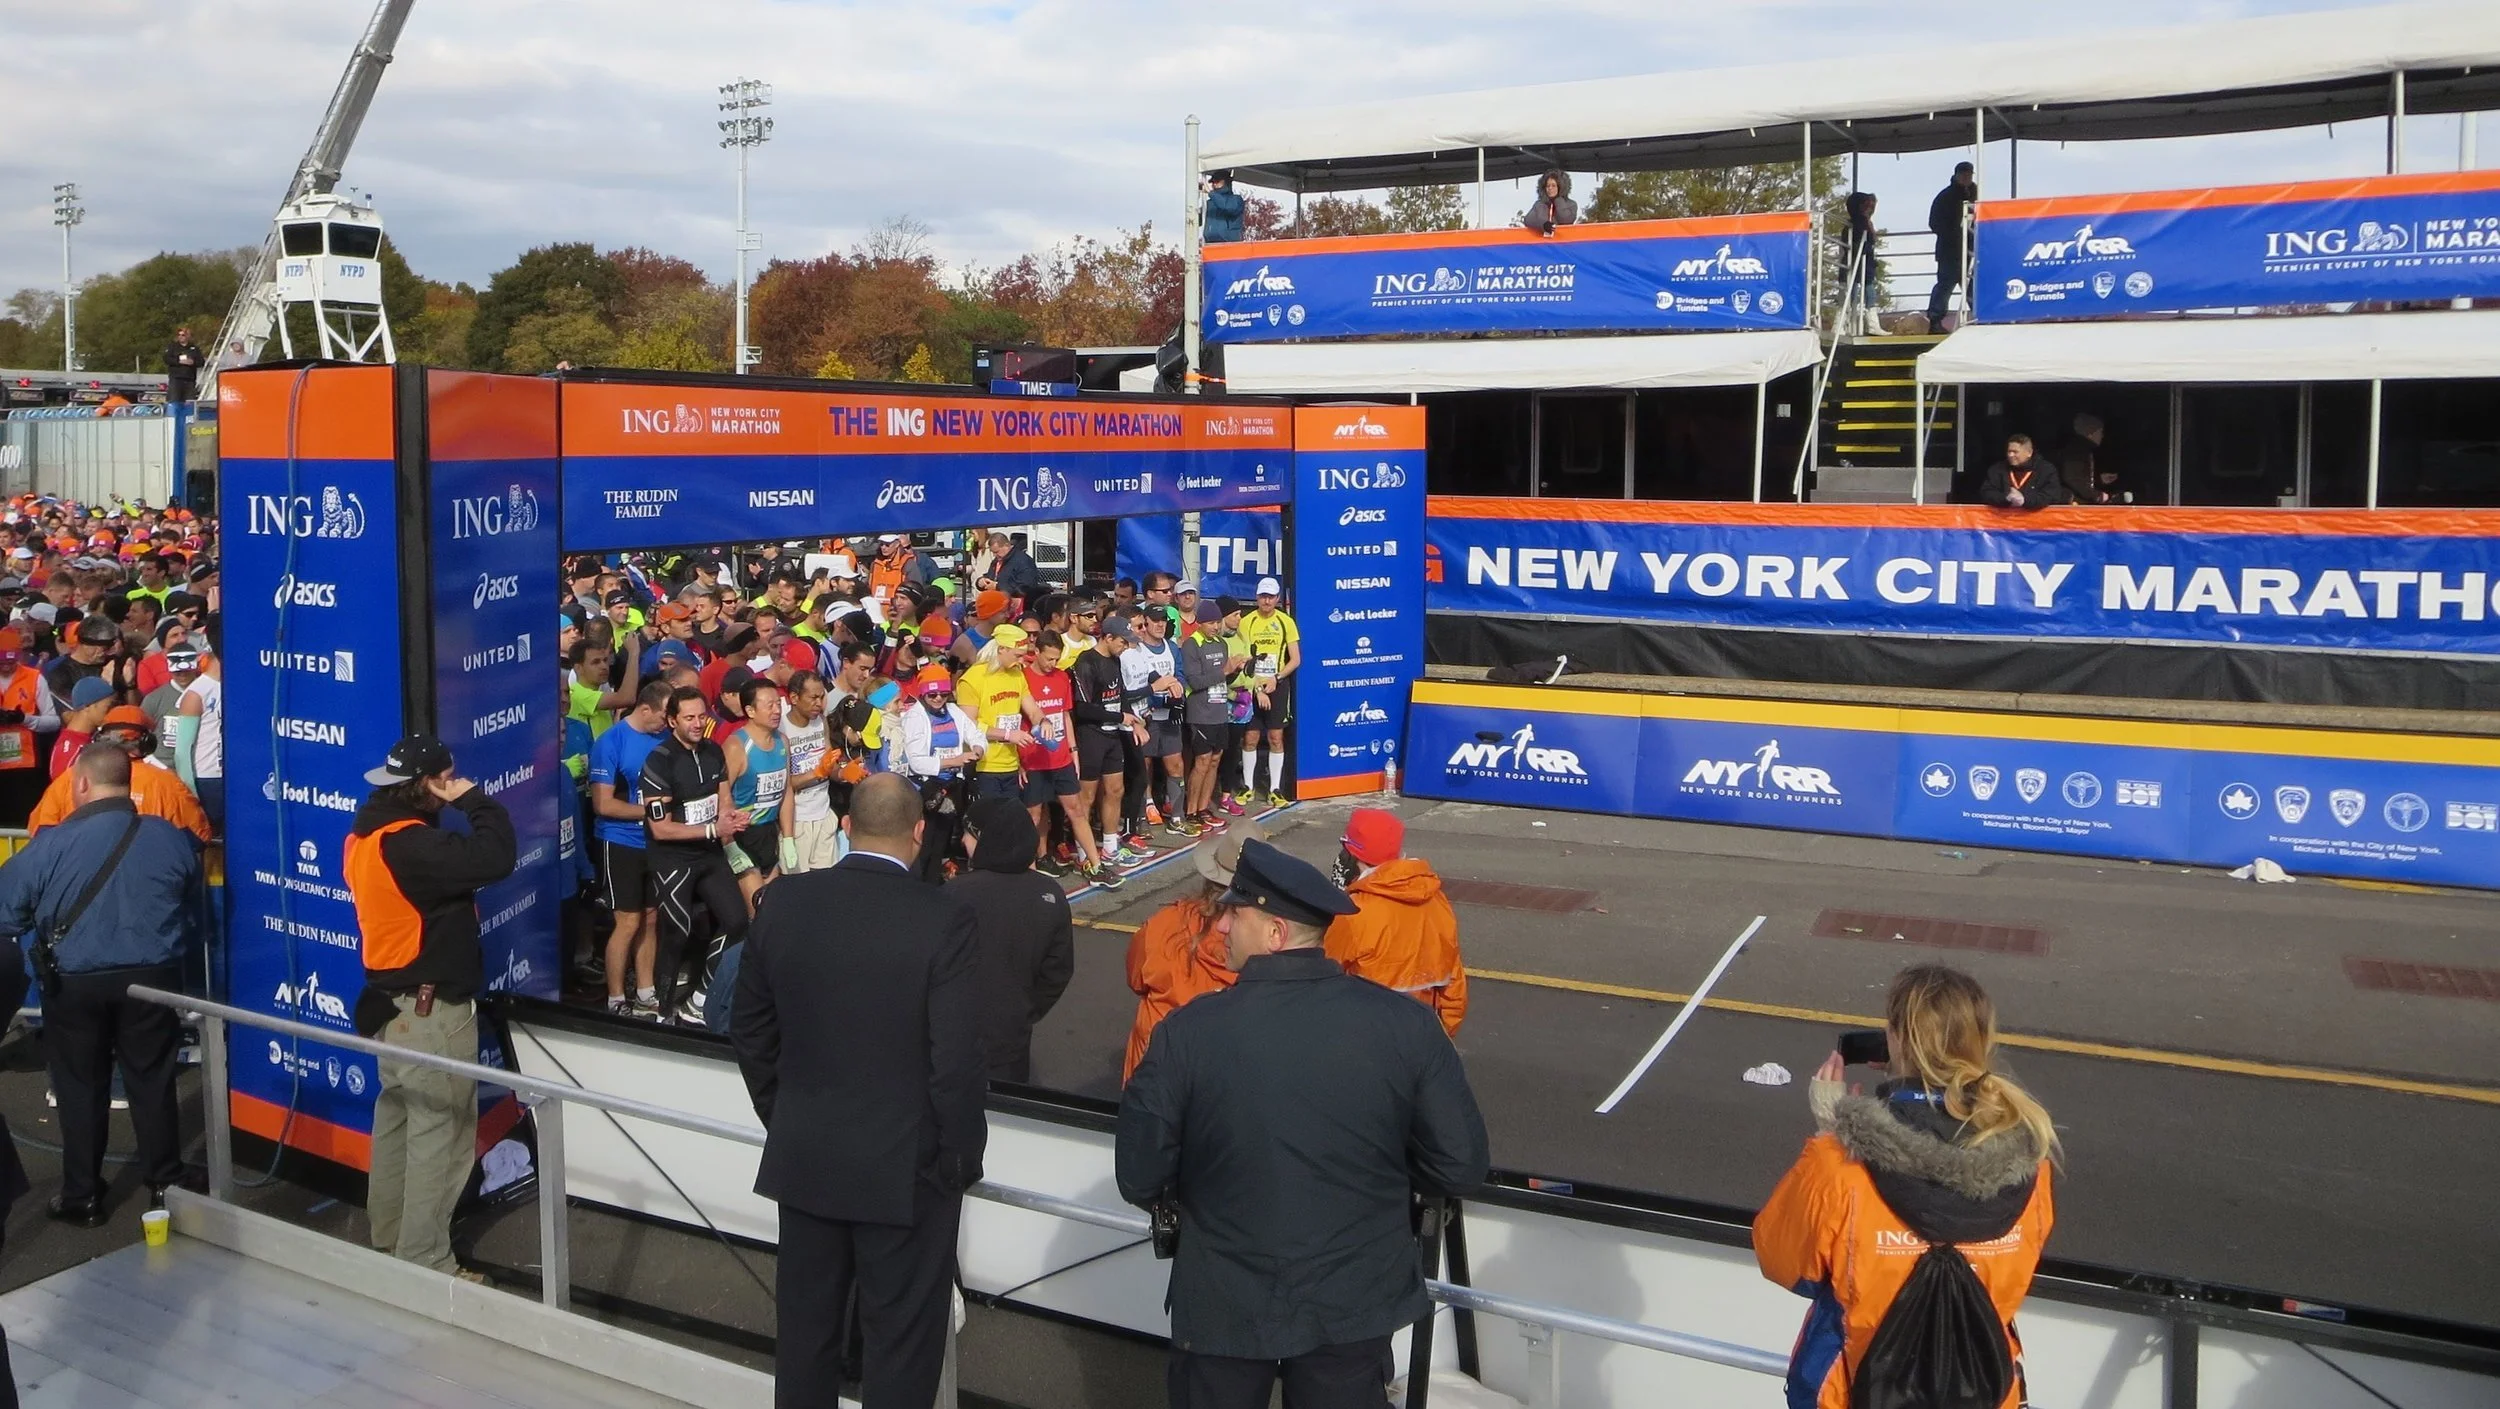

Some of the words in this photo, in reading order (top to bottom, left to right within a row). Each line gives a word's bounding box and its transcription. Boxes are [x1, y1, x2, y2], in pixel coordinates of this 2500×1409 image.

[2426, 219, 2466, 231] NEW
[2474, 217, 2500, 229] YO
[2266, 230, 2347, 256] ING
[2426, 230, 2500, 249] MARA
[2024, 237, 2136, 260] NYRR
[340, 265, 365, 278] NYPD
[1478, 267, 1504, 277] NEW
[1509, 265, 1542, 275] YORK
[1546, 264, 1576, 274] CITY
[1672, 258, 1768, 276] NYRR
[2265, 263, 2320, 273] PREMIER
[2326, 261, 2368, 270] EVENT
[2374, 259, 2389, 267] OF
[1226, 276, 1295, 294] NYRR
[1374, 274, 1426, 295] ING
[1476, 274, 1575, 291] MARATHON
[2029, 282, 2065, 293] Bridges
[2066, 280, 2084, 290] and
[1676, 297, 1707, 306] Bridges
[1709, 296, 1725, 305] and
[2029, 292, 2065, 302] Tunnels
[1020, 381, 1052, 396] TIMEX
[622, 409, 670, 433] ING
[711, 408, 730, 417] NEW
[733, 408, 757, 418] YORK
[760, 408, 780, 418] CITY
[711, 419, 780, 434] MARATHON
[829, 407, 878, 436] THE
[887, 407, 925, 437] ING
[932, 408, 983, 436] NEW
[991, 410, 1043, 436] YORK
[1050, 411, 1090, 436] CITY
[1094, 412, 1182, 437] MARATHON
[1206, 420, 1226, 436] ING
[1243, 426, 1273, 435] MARATHON
[1334, 425, 1388, 435] NYRR
[1094, 478, 1138, 492] UNITED
[1186, 477, 1200, 489] Foot
[1201, 475, 1222, 487] Locker
[1318, 468, 1370, 490] ING
[604, 490, 633, 504] THE
[636, 489, 678, 503] RUDIN
[749, 489, 814, 508] NISSAN
[977, 476, 1030, 513] ING
[248, 495, 314, 538] ING
[453, 496, 502, 539] ING
[615, 504, 663, 519] FAMILY
[1200, 536, 1282, 575] TH
[1328, 545, 1380, 556] UNITED
[1336, 577, 1390, 590] NISSAN
[1467, 546, 1618, 592] NEW
[1644, 552, 1850, 600] YORK
[1875, 557, 2075, 608] CITY
[2103, 564, 2500, 621] MARATH
[1345, 611, 1365, 621] Foot
[1368, 609, 1397, 619] Locker
[260, 650, 330, 674] UNITED
[463, 644, 515, 672] UNITED
[1340, 656, 1379, 665] CONSULTANCY
[1329, 681, 1345, 689] THE
[1346, 679, 1370, 688] RUDIN
[1371, 677, 1395, 685] FAMILY
[473, 704, 526, 739] NISSAN
[1335, 709, 1388, 723] NYRR
[271, 716, 345, 746] NISSAN
[1447, 743, 1588, 775] NYRR
[484, 776, 503, 796] Foot
[505, 764, 534, 791] Locker
[1446, 767, 1468, 776] NEW
[1473, 770, 1500, 778] YORK
[1505, 772, 1534, 781] ROAD
[1539, 776, 1589, 785] RUNNERS
[1682, 760, 1841, 795] NYRR
[283, 782, 309, 805] Foot
[313, 789, 357, 813] Locker
[1680, 786, 1703, 794] NEW
[1711, 789, 1741, 797] YORK
[1748, 791, 1780, 801] ROAD
[1786, 795, 1842, 805] RUNNERS
[2046, 817, 2061, 826] City
[255, 870, 276, 886] TATA
[297, 862, 320, 877] TATA
[492, 904, 514, 929] RUDIN
[515, 890, 536, 915] FAMILY
[263, 915, 284, 932] THE
[320, 929, 358, 950] FAMILY
[274, 982, 350, 1020] NYRR
[1876, 1230, 1918, 1246] ING
